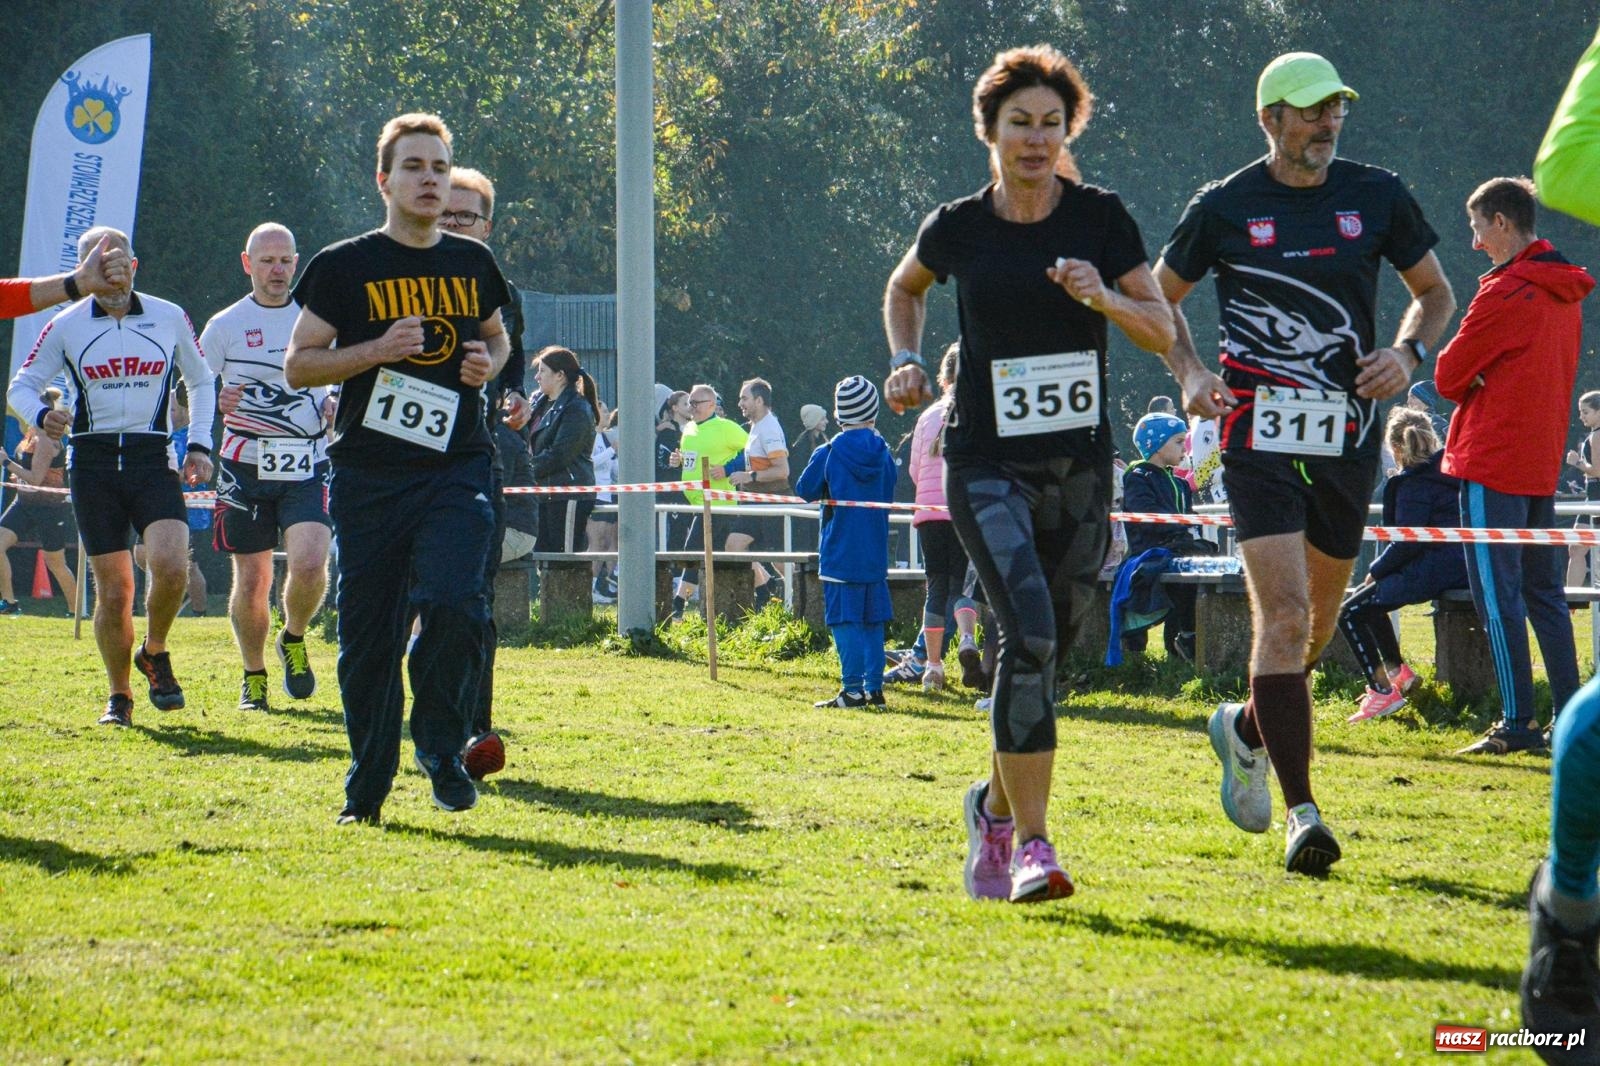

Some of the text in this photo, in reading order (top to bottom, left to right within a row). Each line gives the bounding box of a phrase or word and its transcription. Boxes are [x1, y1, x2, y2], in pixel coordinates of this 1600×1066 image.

[64, 152, 103, 239] STOWARZYSZENIE
[364, 276, 480, 321] NIRVANA
[83, 357, 165, 380] RAFAKO
[377, 393, 449, 437] 193
[1003, 380, 1093, 420] 356
[1260, 410, 1335, 443] 311
[262, 453, 311, 473] 324
